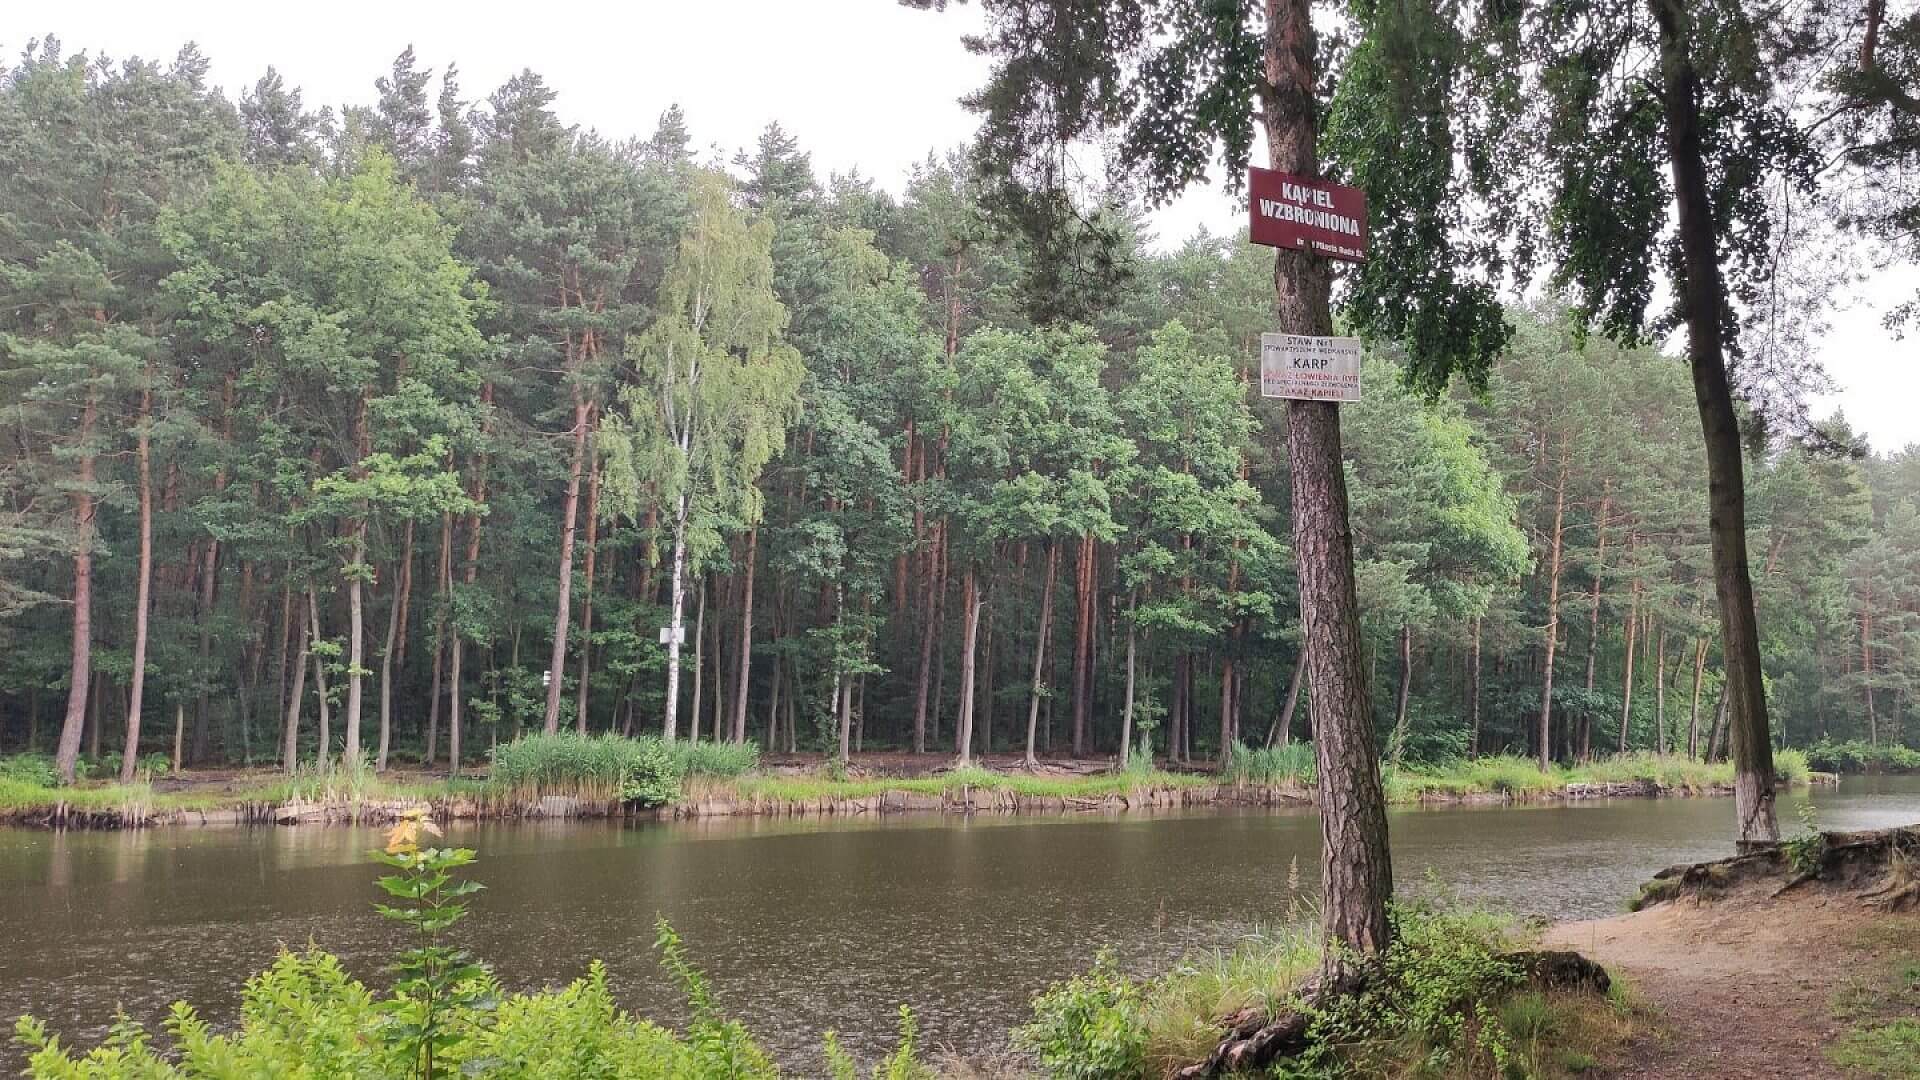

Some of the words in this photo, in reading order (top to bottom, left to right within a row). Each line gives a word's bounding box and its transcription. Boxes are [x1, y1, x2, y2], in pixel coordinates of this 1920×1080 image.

[1282, 182, 1335, 208] KĄPIEL
[1259, 198, 1360, 236] WZBRONIONA
[1287, 337, 1312, 345] STAW
